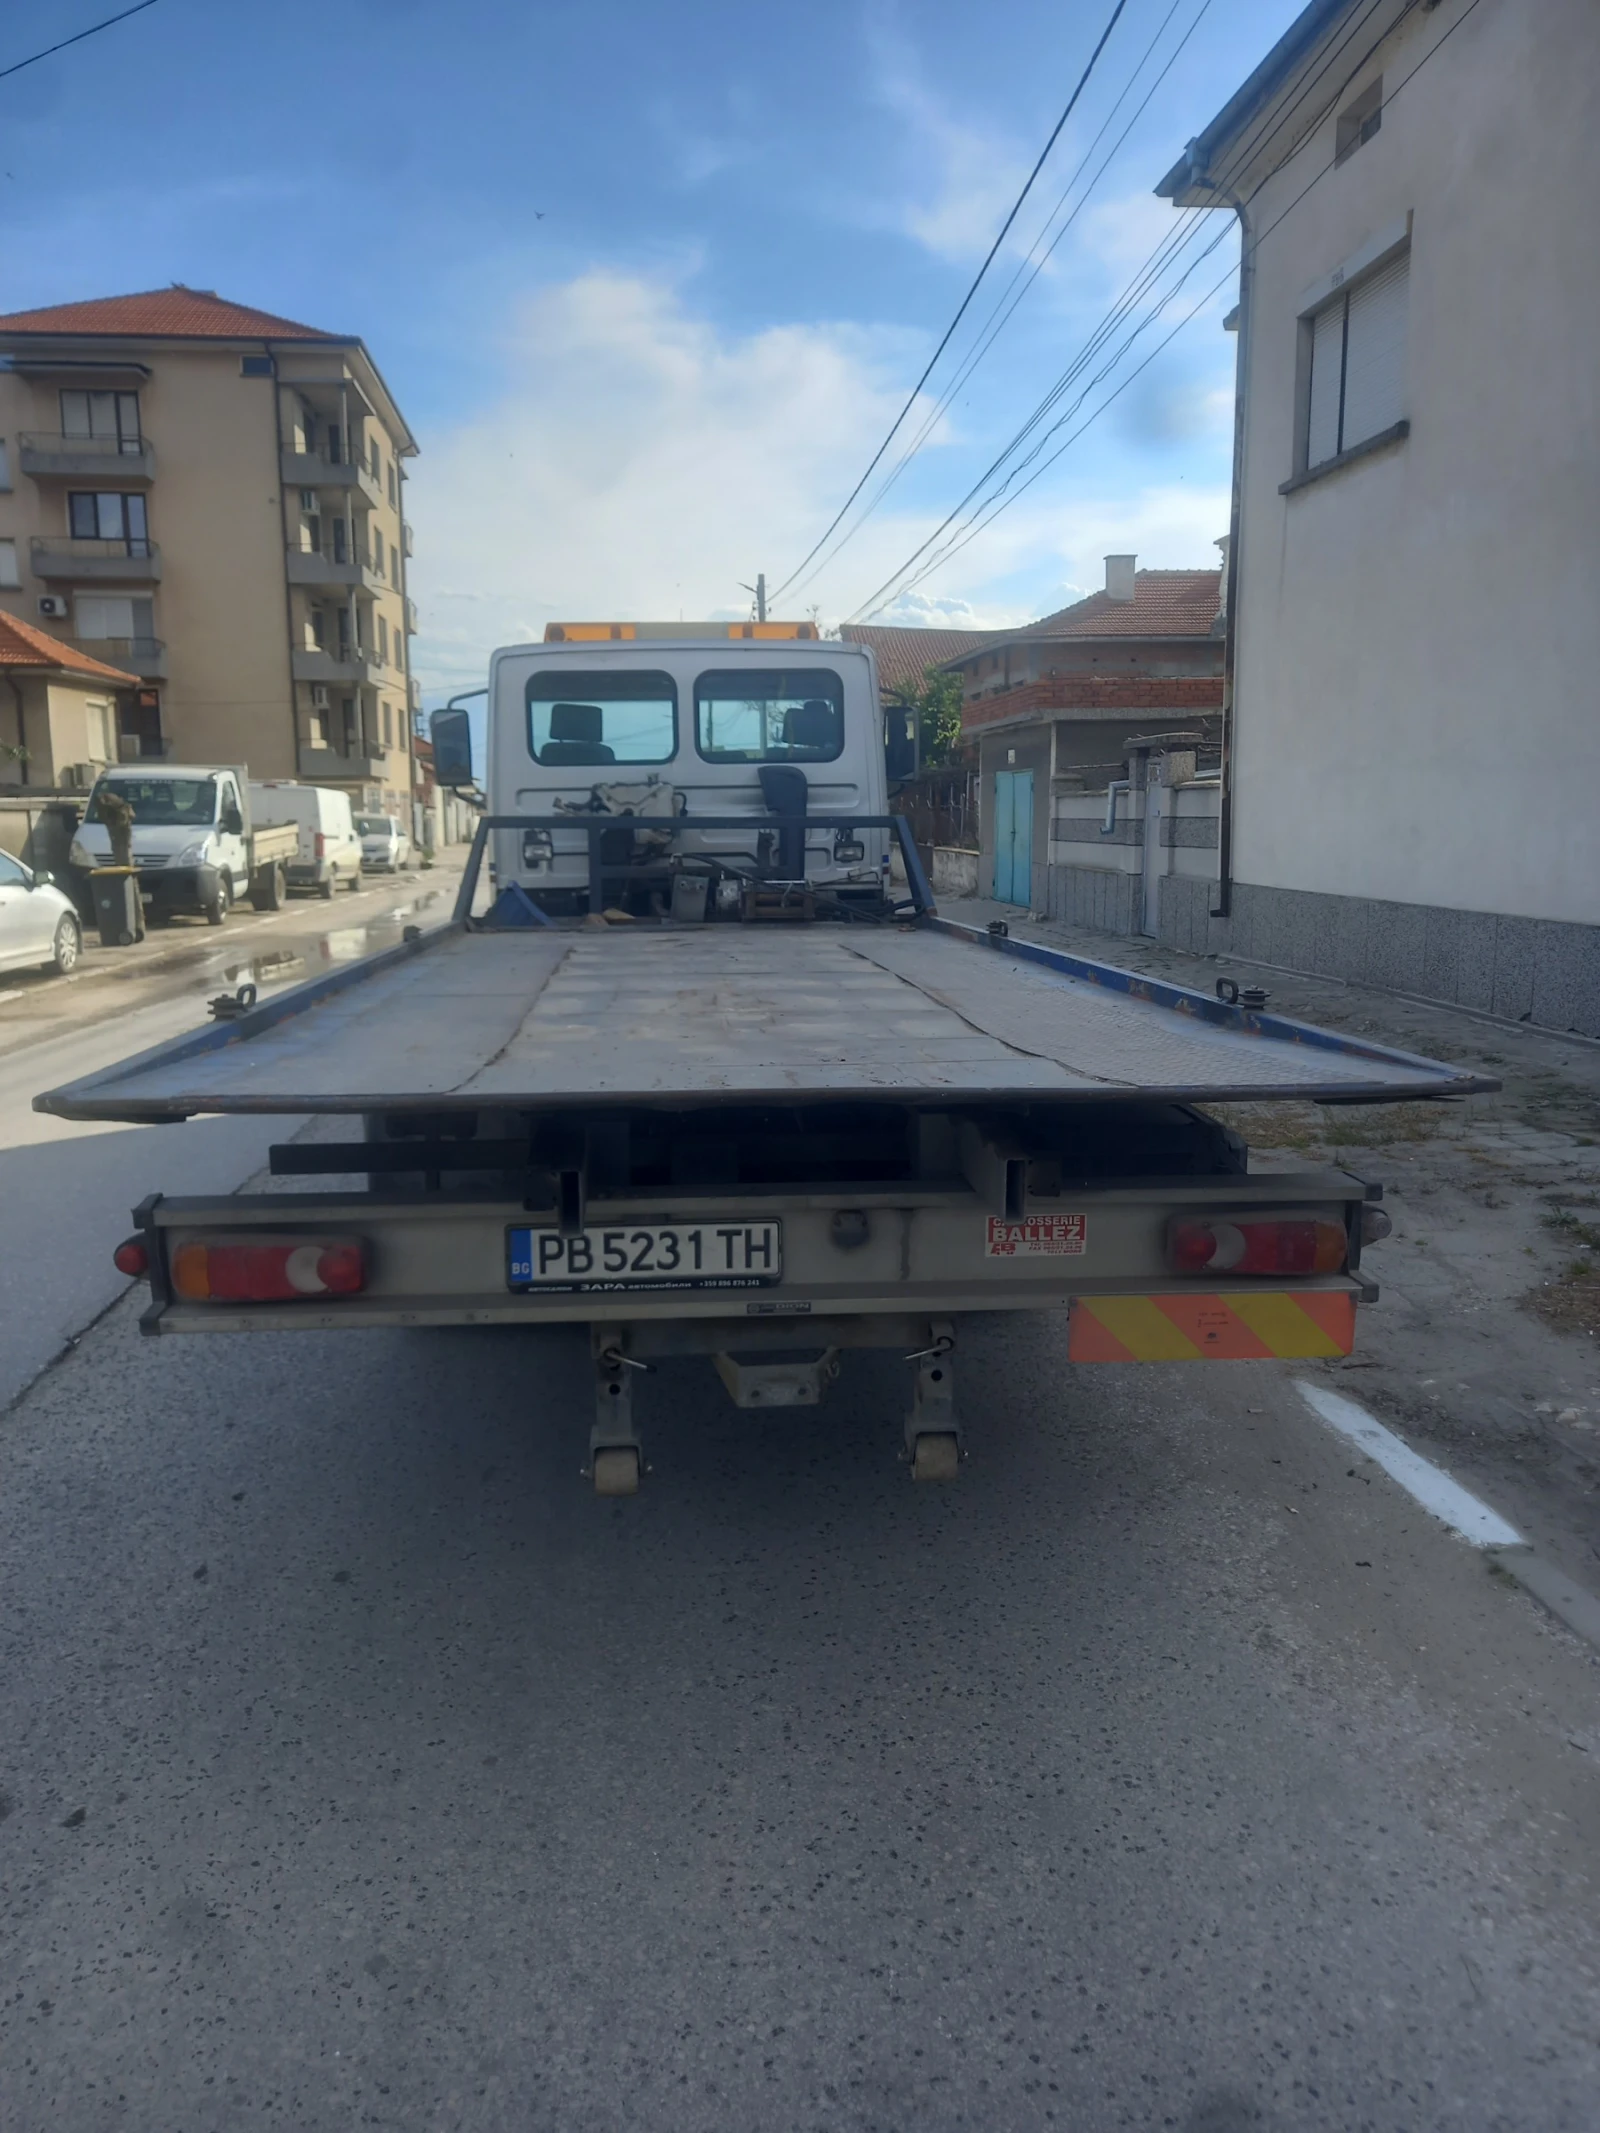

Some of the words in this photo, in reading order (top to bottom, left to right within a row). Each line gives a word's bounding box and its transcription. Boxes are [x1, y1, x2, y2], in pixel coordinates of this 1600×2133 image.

[993, 1216, 1081, 1227] COSSERIE
[992, 1226, 1081, 1242] BALLEZ
[603, 1229, 702, 1272] 5231
[511, 1262, 530, 1275] BG
